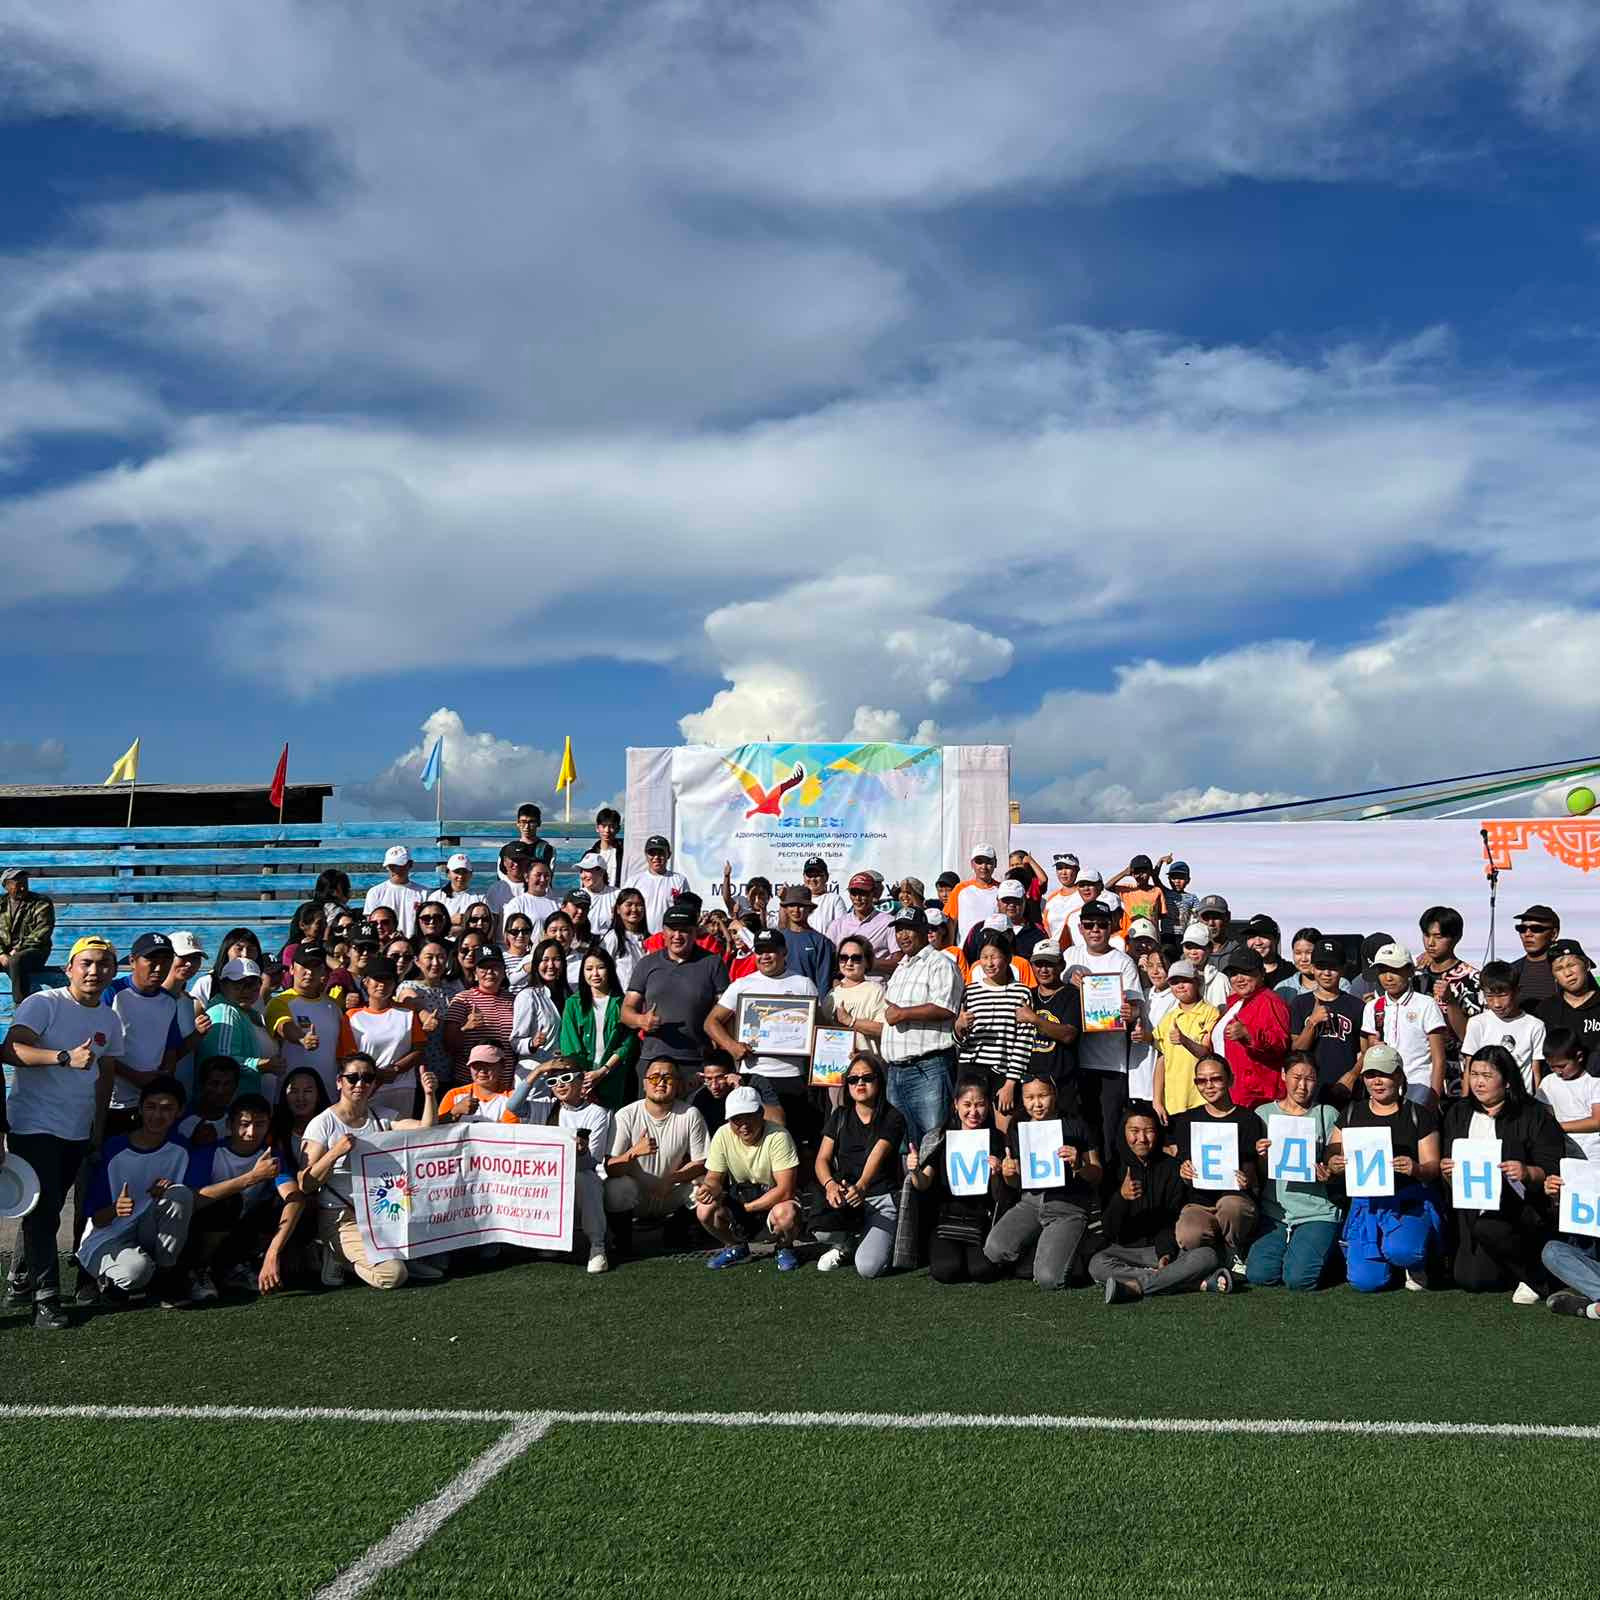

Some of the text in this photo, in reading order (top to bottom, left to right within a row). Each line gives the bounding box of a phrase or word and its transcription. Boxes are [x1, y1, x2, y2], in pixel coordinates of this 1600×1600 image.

[415, 1155, 558, 1179] СОВЕТ МОЛОДЕЖИ
[950, 1150, 988, 1186] М
[1200, 1144, 1224, 1180] Е
[1274, 1137, 1311, 1181] Д
[1354, 1149, 1387, 1187] И
[471, 1182, 551, 1199] САГЛЫНСКИЙ
[1462, 1160, 1494, 1200] Н
